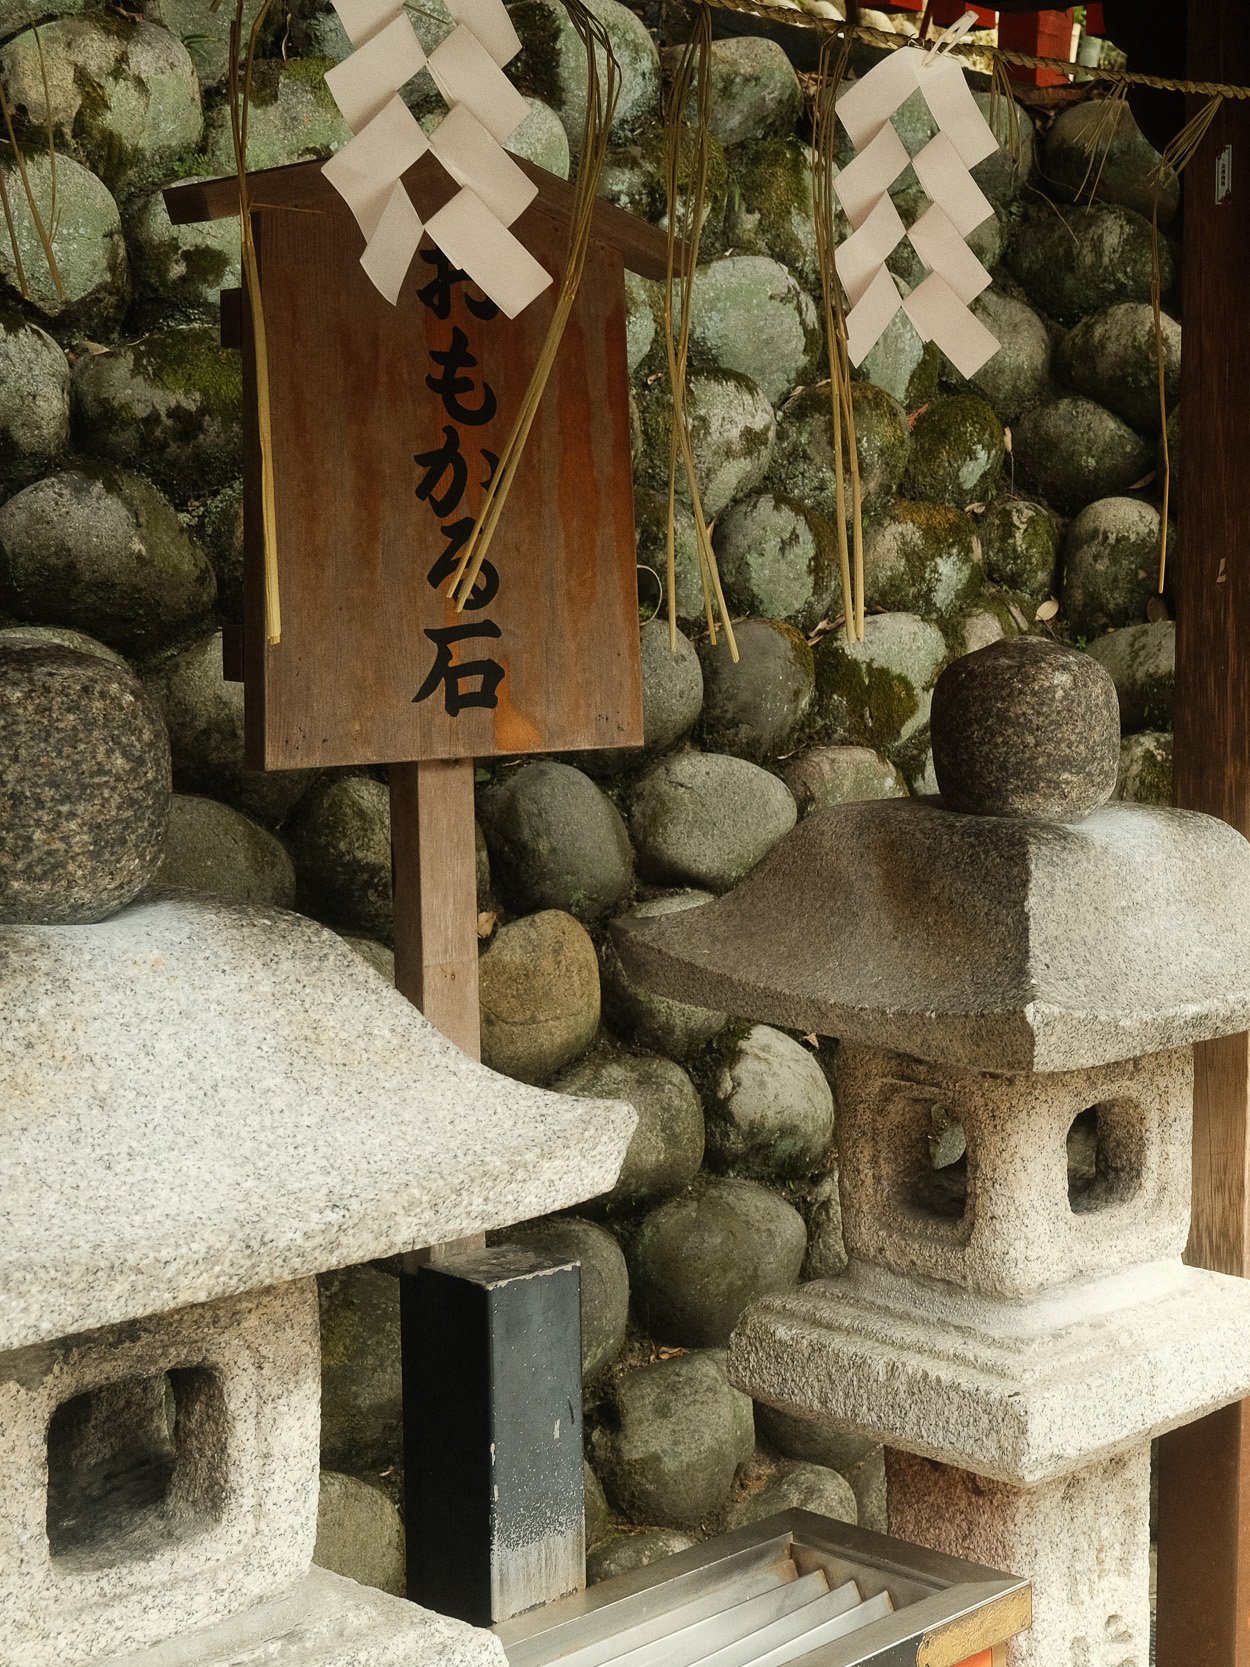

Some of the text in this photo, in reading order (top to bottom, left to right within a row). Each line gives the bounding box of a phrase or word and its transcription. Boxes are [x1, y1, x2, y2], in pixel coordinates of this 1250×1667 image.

[411, 246, 506, 717] おもかる石
